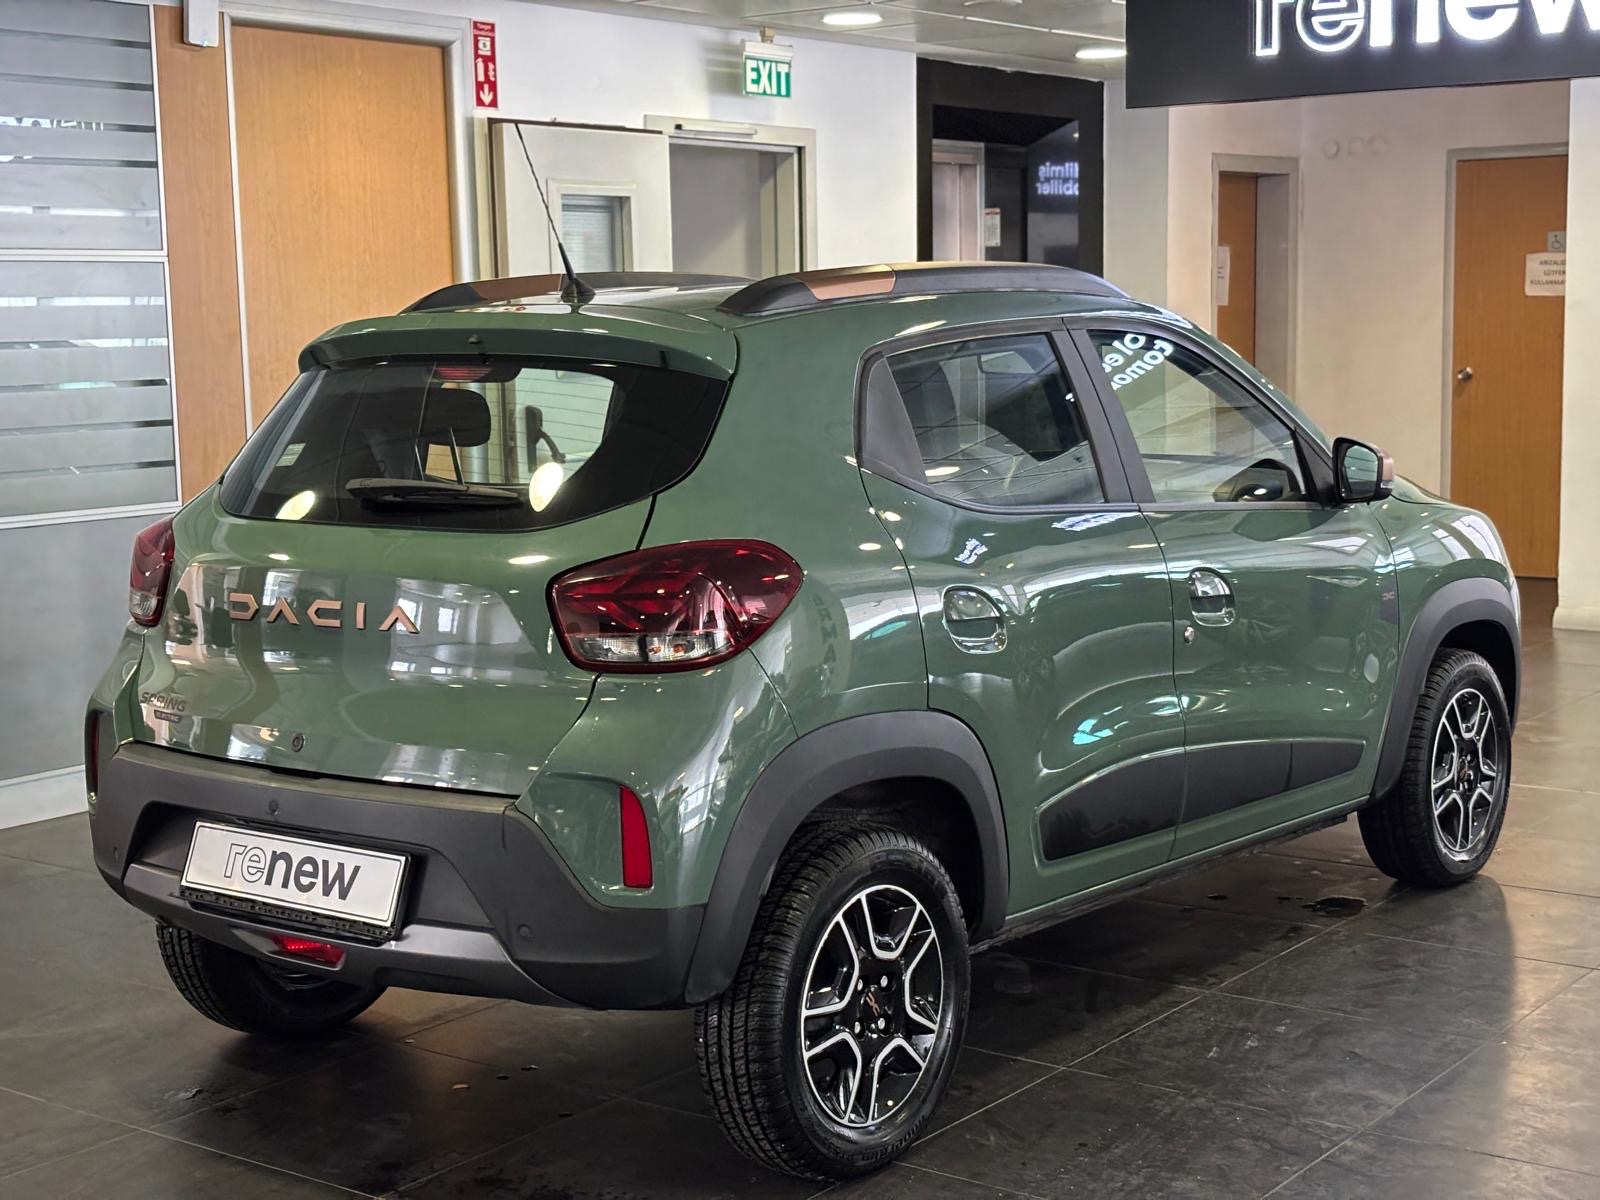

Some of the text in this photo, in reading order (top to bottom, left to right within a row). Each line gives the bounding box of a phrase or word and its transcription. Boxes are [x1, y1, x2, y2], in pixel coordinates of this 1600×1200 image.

[745, 58, 789, 96] EXIT
[229, 592, 420, 634] DACIA
[140, 691, 187, 713] SPRING
[224, 843, 361, 901] renew
